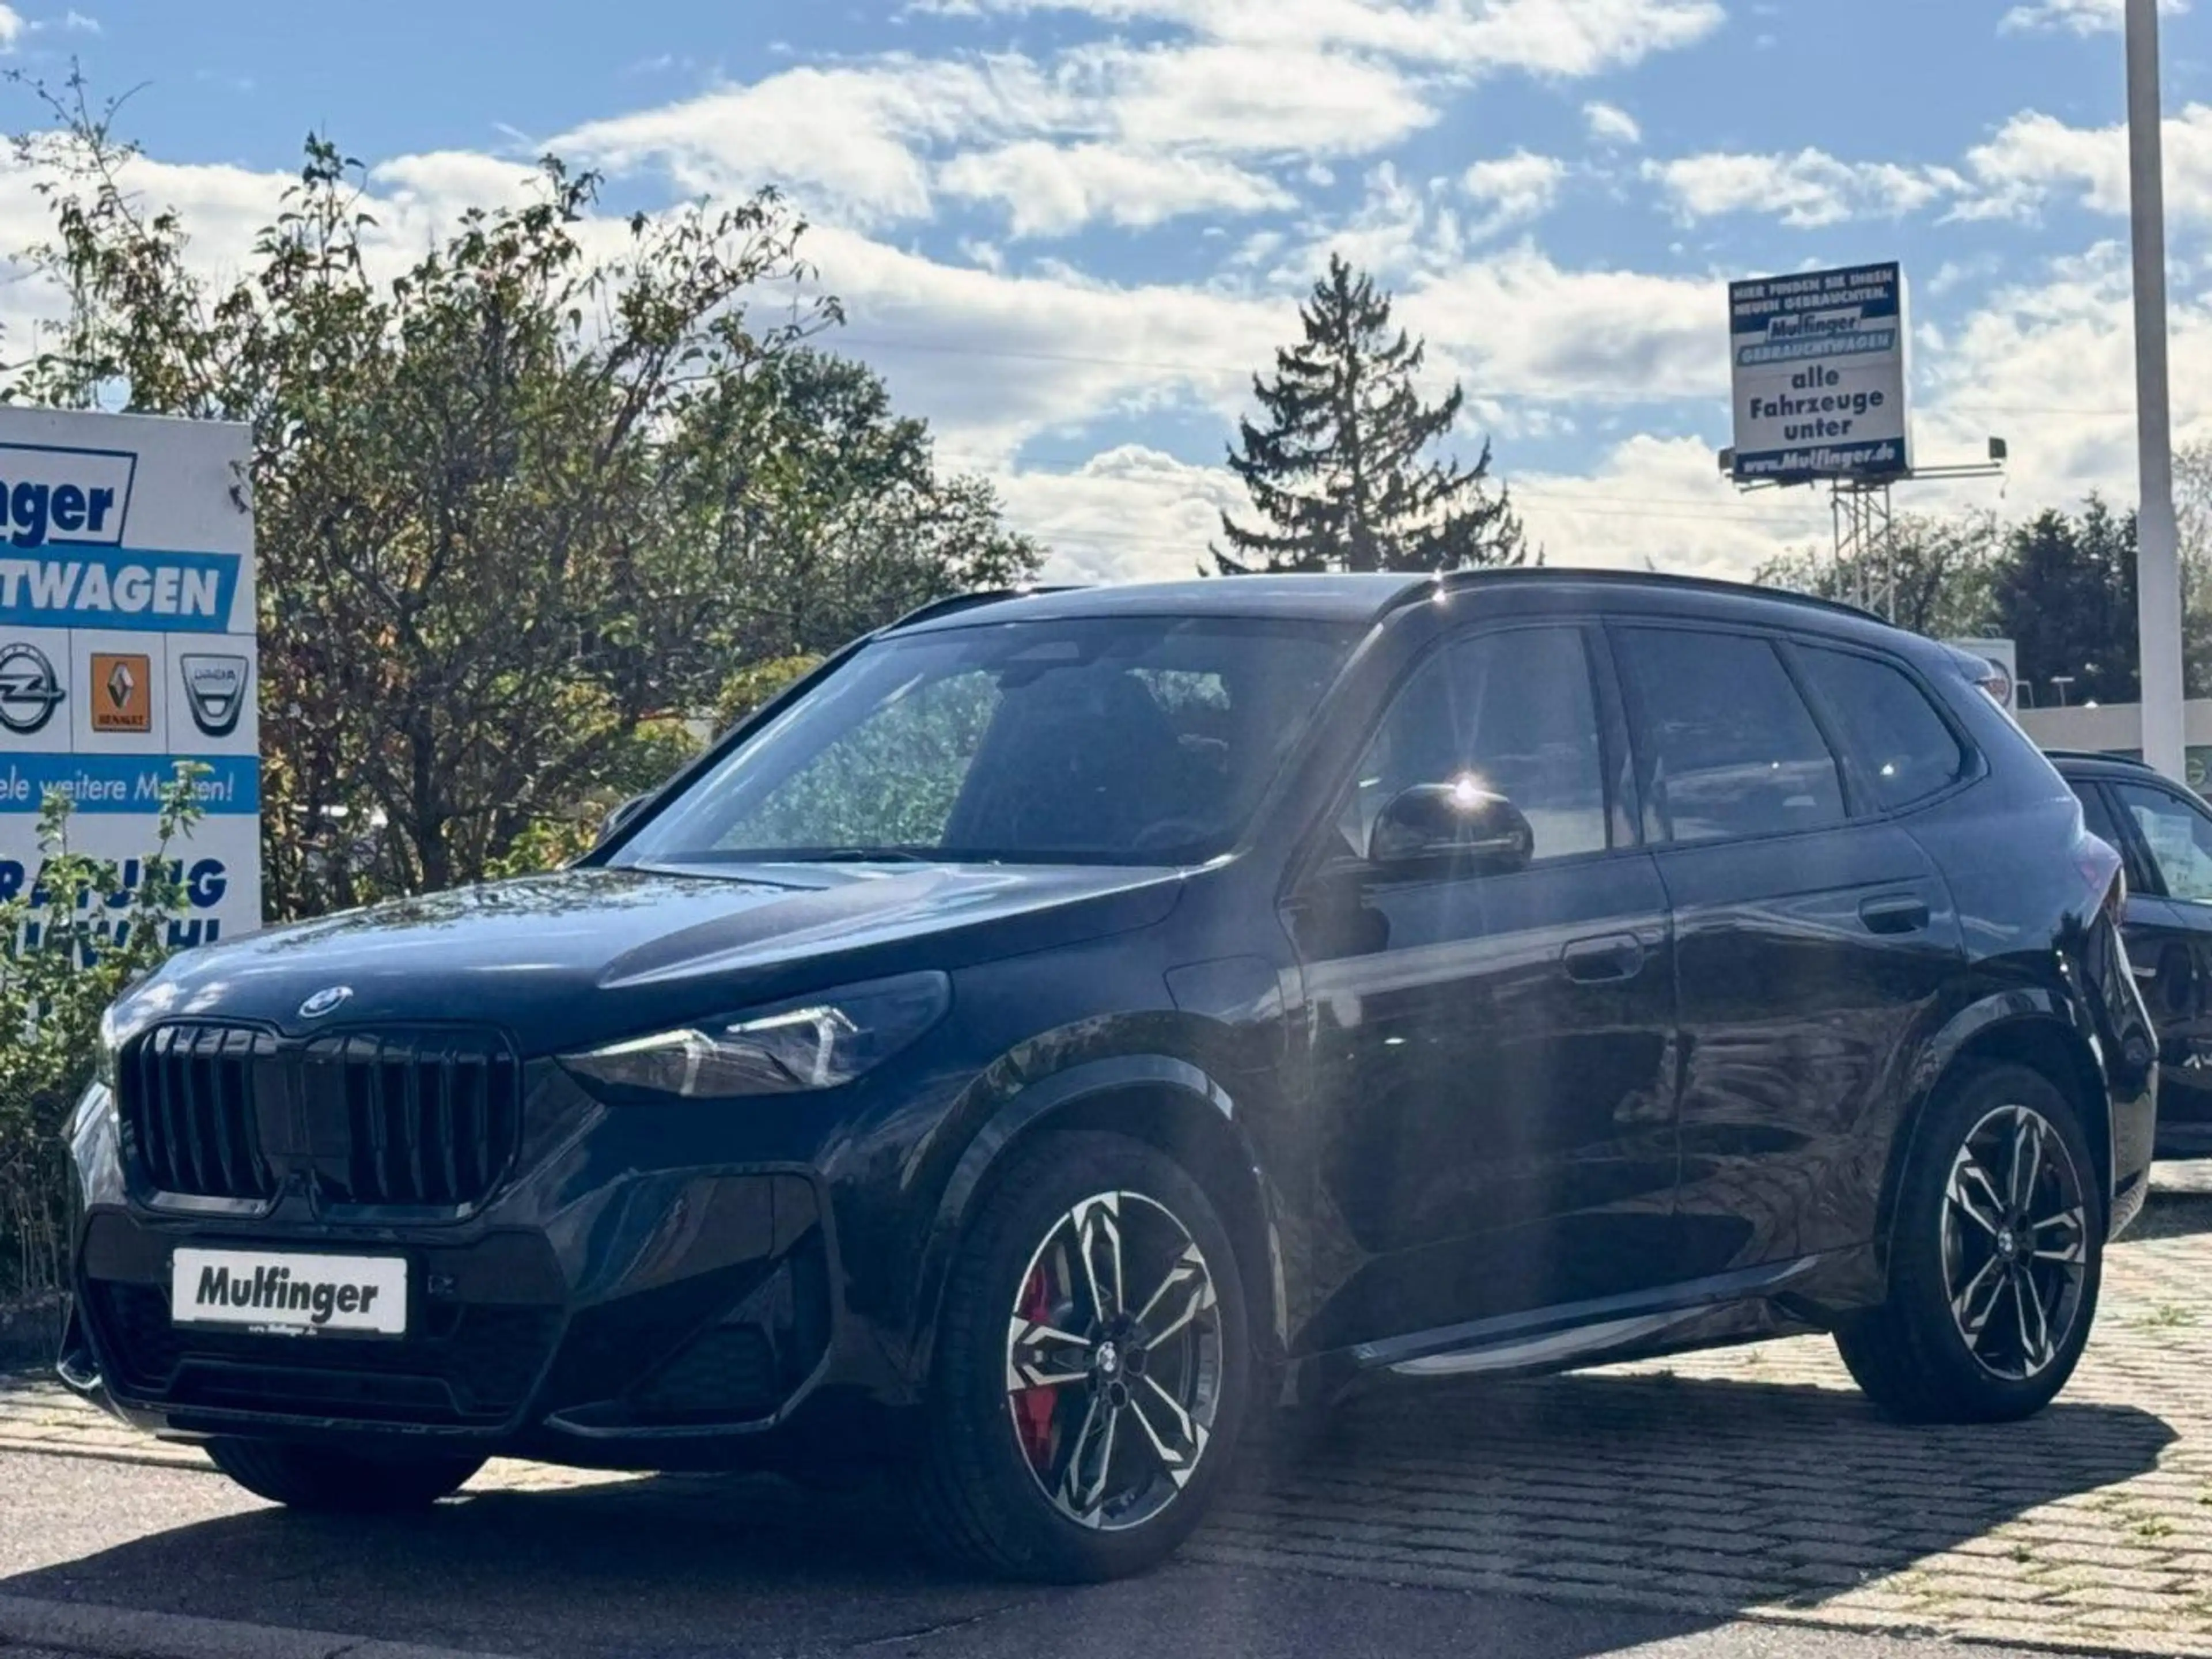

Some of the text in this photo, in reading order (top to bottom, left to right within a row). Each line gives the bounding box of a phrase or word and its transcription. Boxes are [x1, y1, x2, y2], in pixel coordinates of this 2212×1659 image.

[1825, 274, 1846, 290] SIE
[1771, 314, 1856, 337] Mulfinger
[1791, 365, 1839, 389] alle
[1750, 390, 1884, 419] Fahrzeuge
[1784, 418, 1853, 440] unter
[1743, 442, 1895, 473] www.Mulfinger.de
[0, 480, 114, 548] ger
[39, 770, 127, 801] weitere
[196, 1265, 378, 1324] Mulfinger
